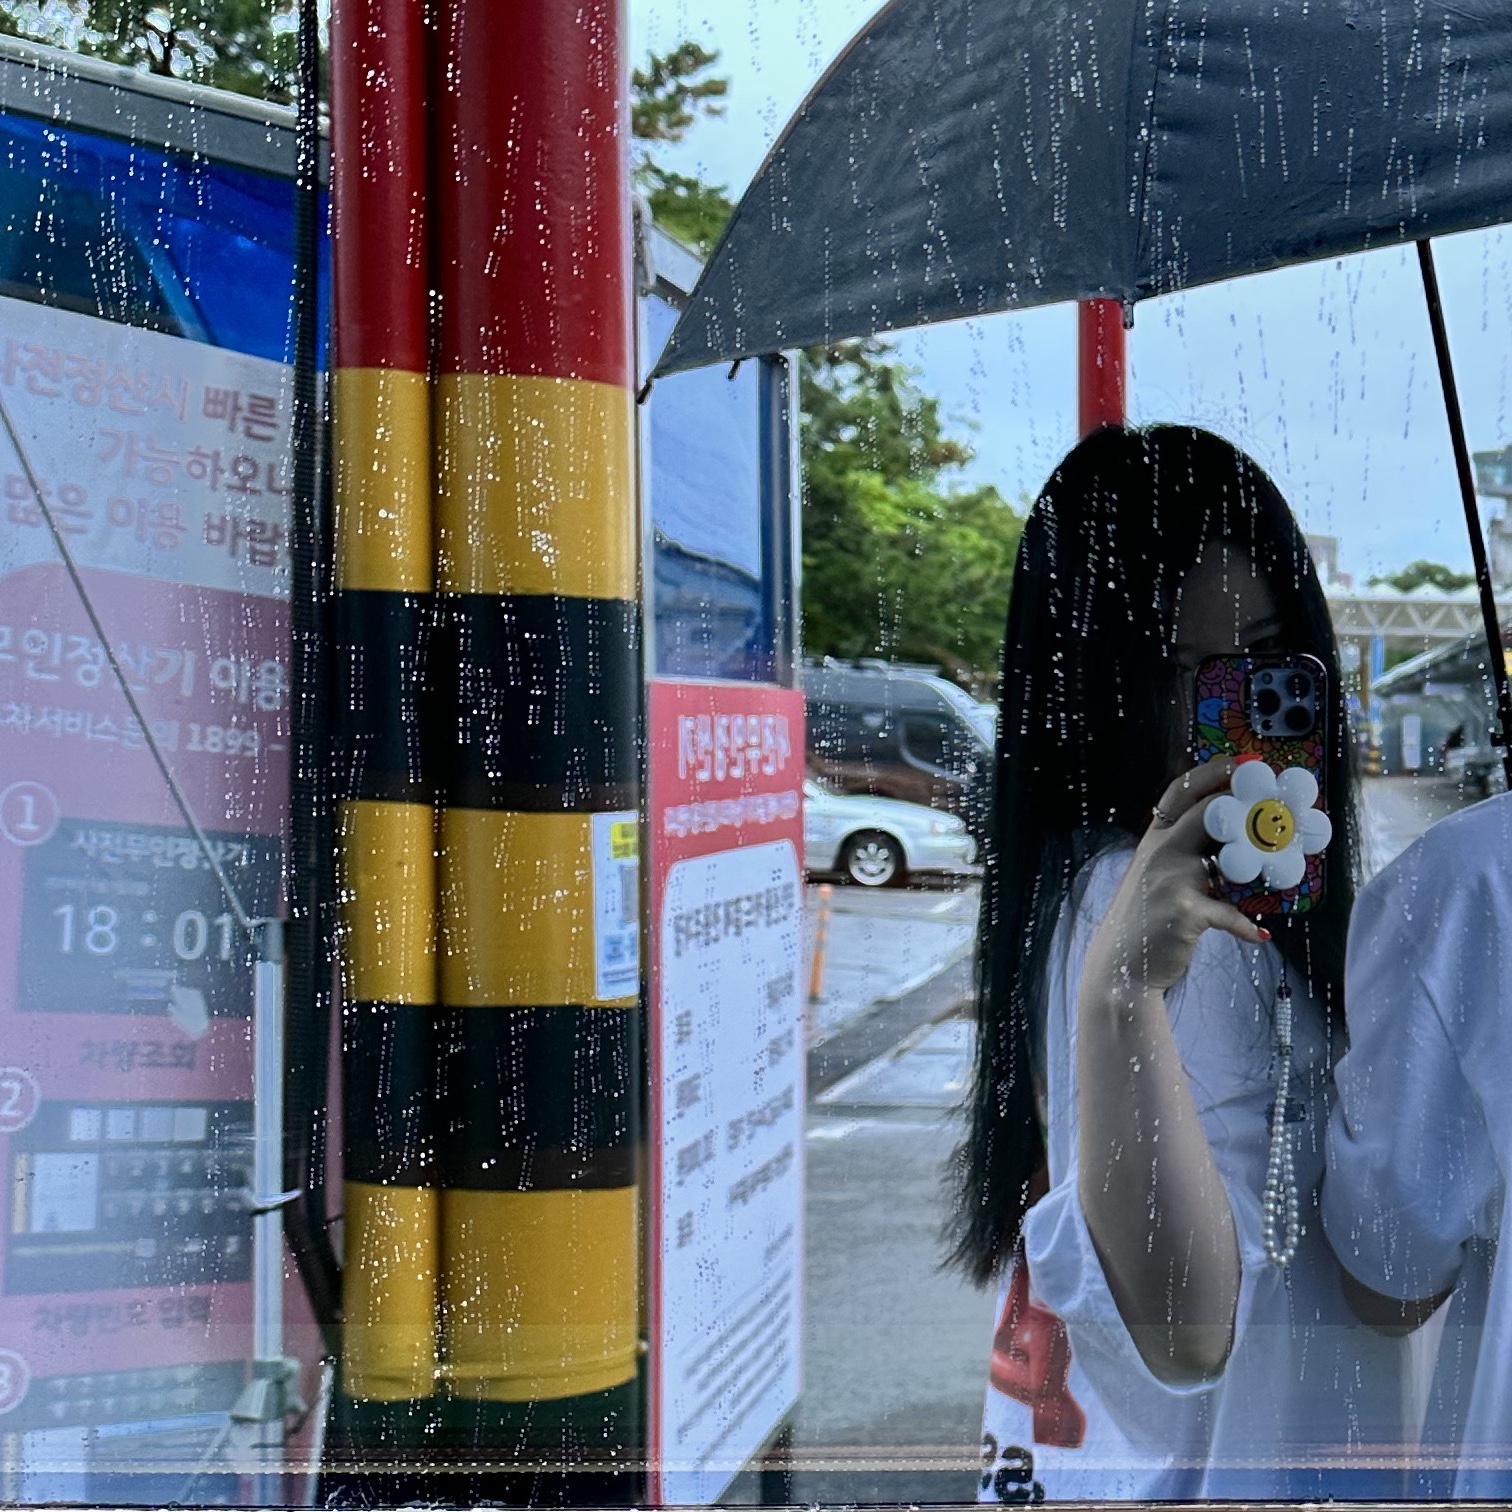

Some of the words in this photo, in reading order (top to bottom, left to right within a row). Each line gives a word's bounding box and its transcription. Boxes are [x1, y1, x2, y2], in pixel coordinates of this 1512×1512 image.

[201, 386, 281, 442] 빠른
[107, 496, 189, 551] 이용
[211, 656, 290, 711] 이용
